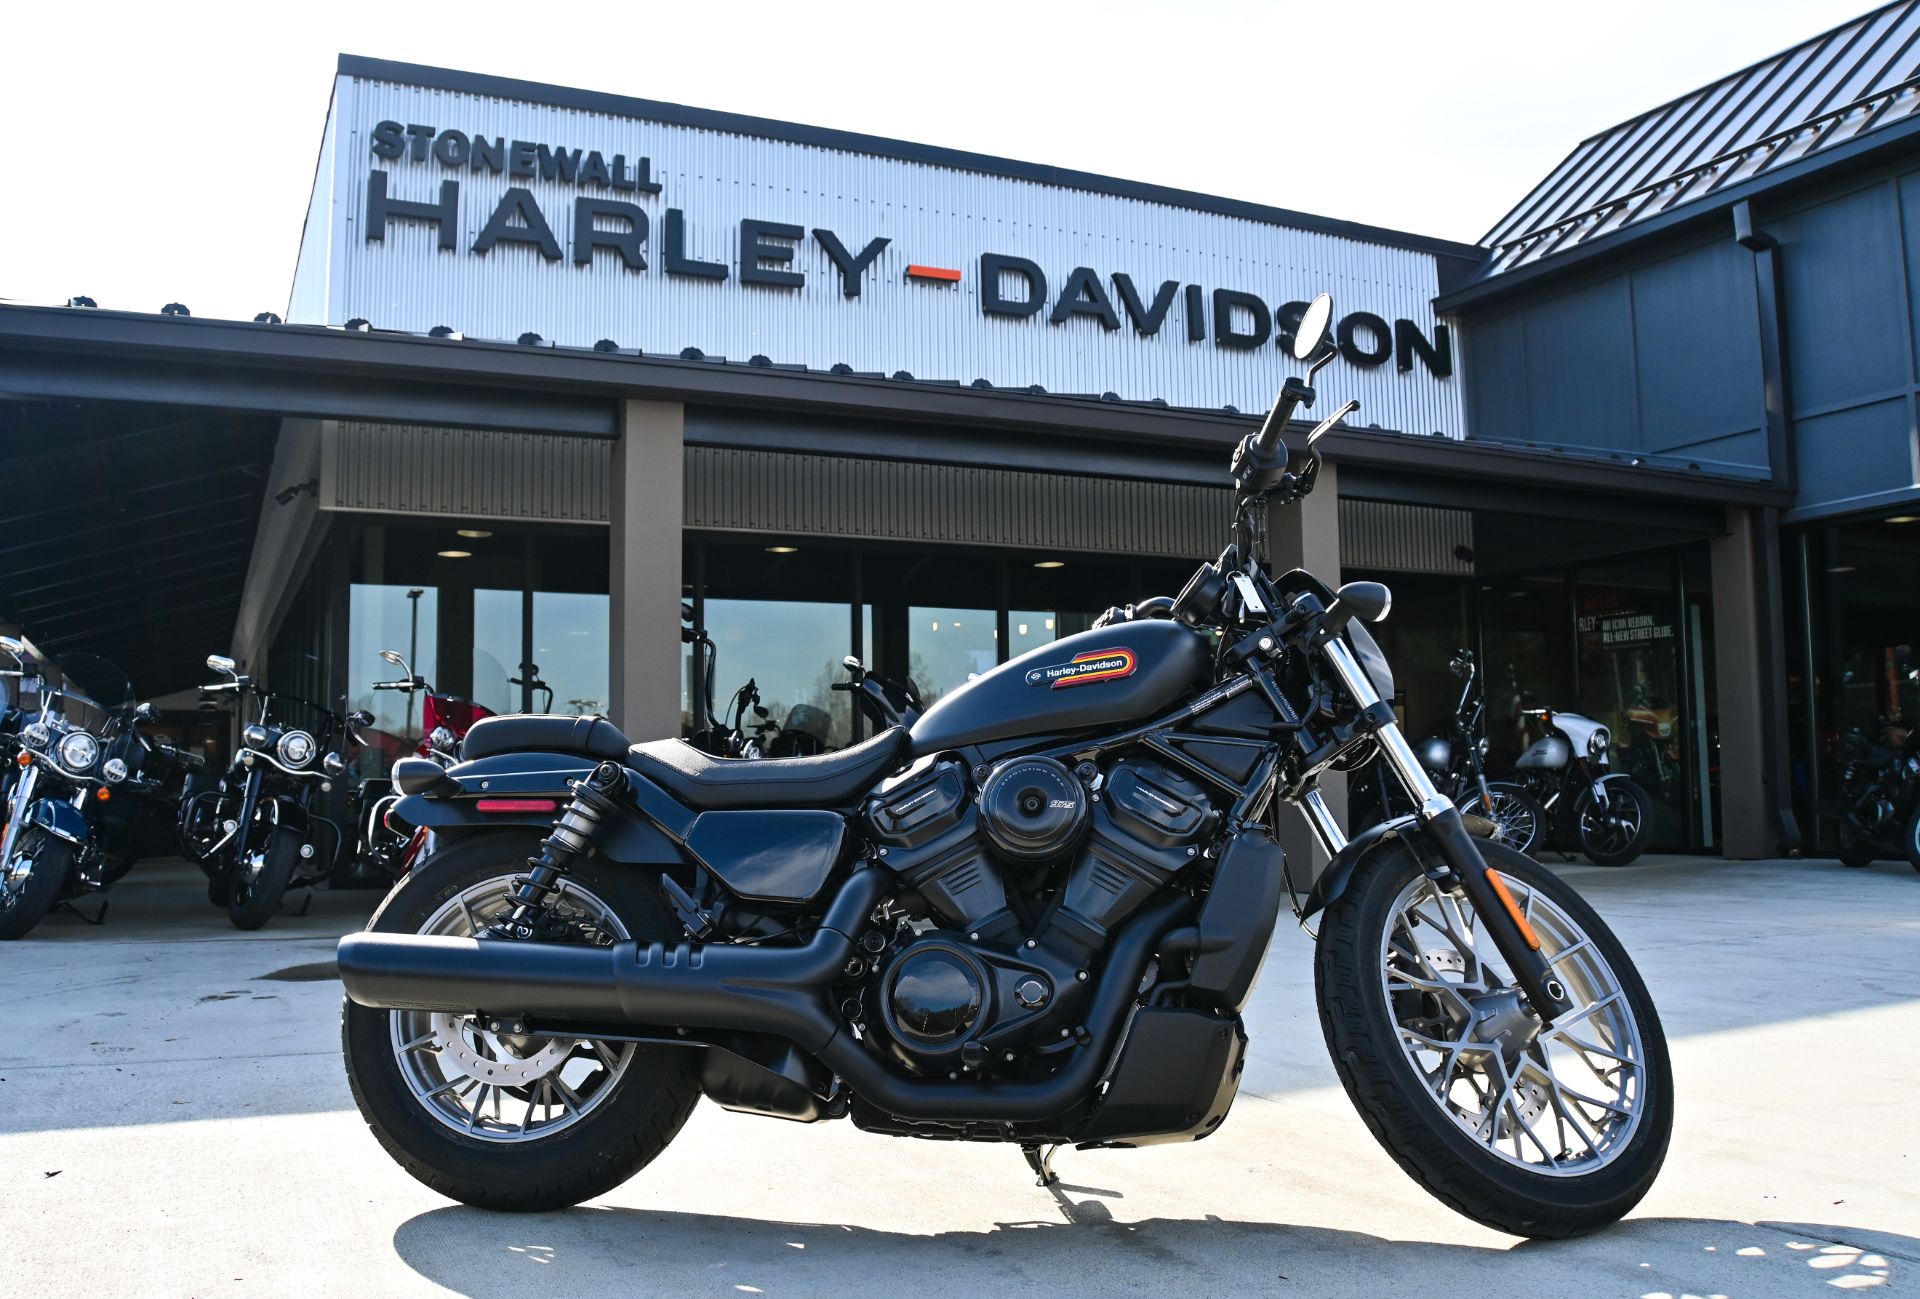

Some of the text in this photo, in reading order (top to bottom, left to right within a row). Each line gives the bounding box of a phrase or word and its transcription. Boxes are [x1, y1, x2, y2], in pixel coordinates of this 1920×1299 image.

[372, 120, 662, 194] STONEWALL
[1630, 627, 1653, 640] STREET
[1046, 659, 1123, 678] Harley-Davidson
[1049, 799, 1076, 809] 975
